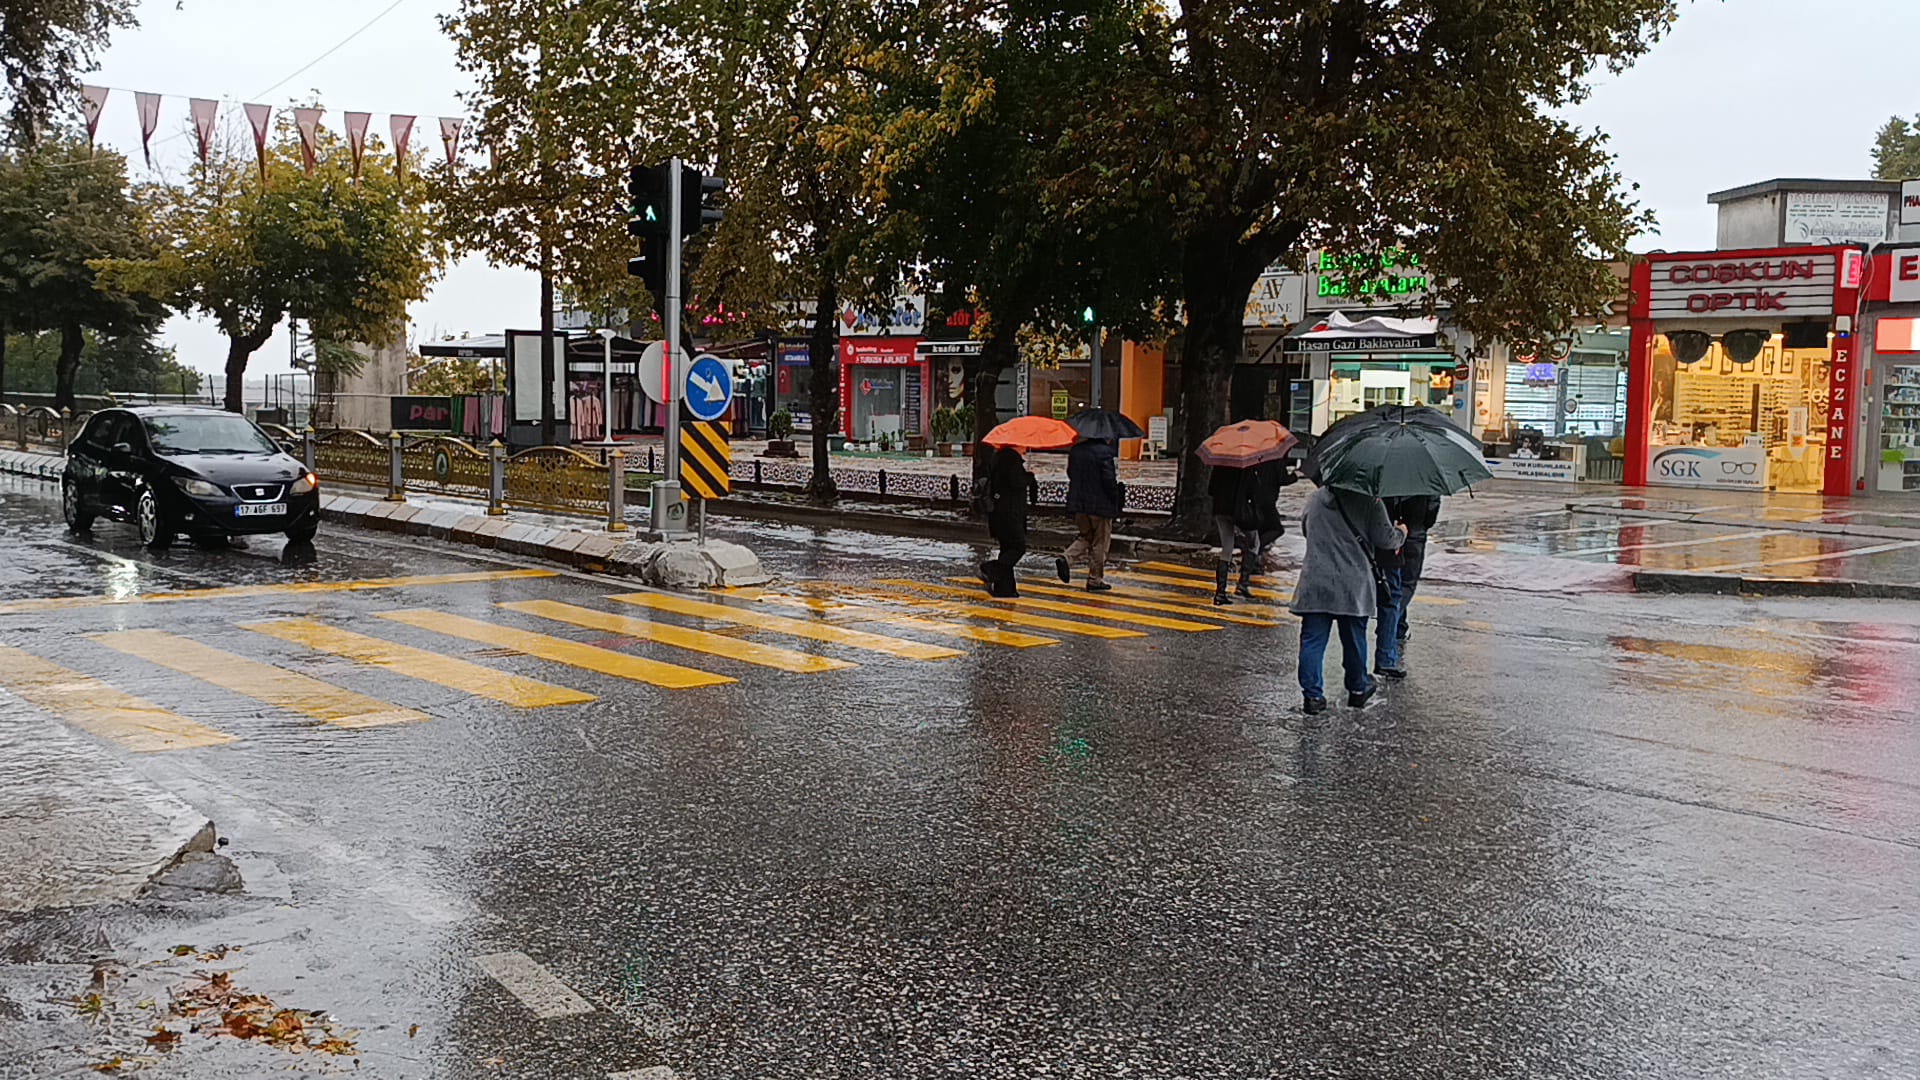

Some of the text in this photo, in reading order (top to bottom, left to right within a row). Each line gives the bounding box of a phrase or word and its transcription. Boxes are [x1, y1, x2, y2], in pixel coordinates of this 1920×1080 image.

[1899, 255, 1919, 281] E
[1686, 286, 1788, 313] OPTİK
[1298, 337, 1421, 351] Hasan Gazi Baklavaları
[1830, 349, 1849, 459] ECZANE
[1660, 459, 1701, 478] SGK
[240, 506, 250, 514] 17
